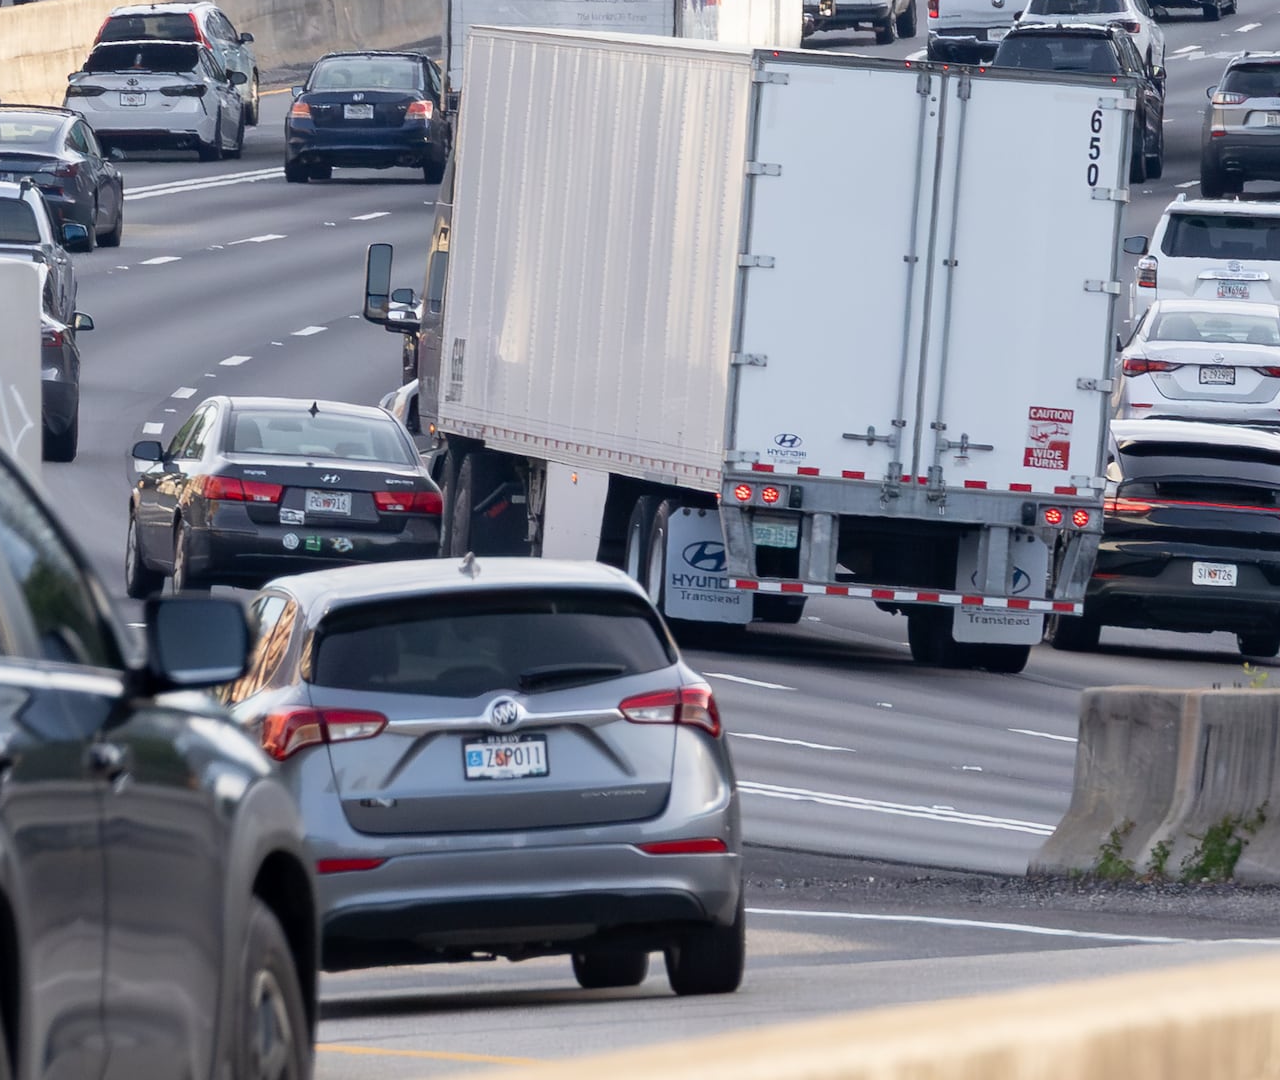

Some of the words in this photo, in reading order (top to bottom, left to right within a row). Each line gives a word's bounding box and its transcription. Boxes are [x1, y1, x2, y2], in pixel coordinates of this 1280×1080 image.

[1087, 109, 1103, 187] 650
[1029, 407, 1073, 420] CAUTION
[1032, 448, 1062, 460] WIDE
[1028, 457, 1064, 469] TURNS
[680, 590, 740, 605] Translead
[968, 613, 1030, 626] Translead
